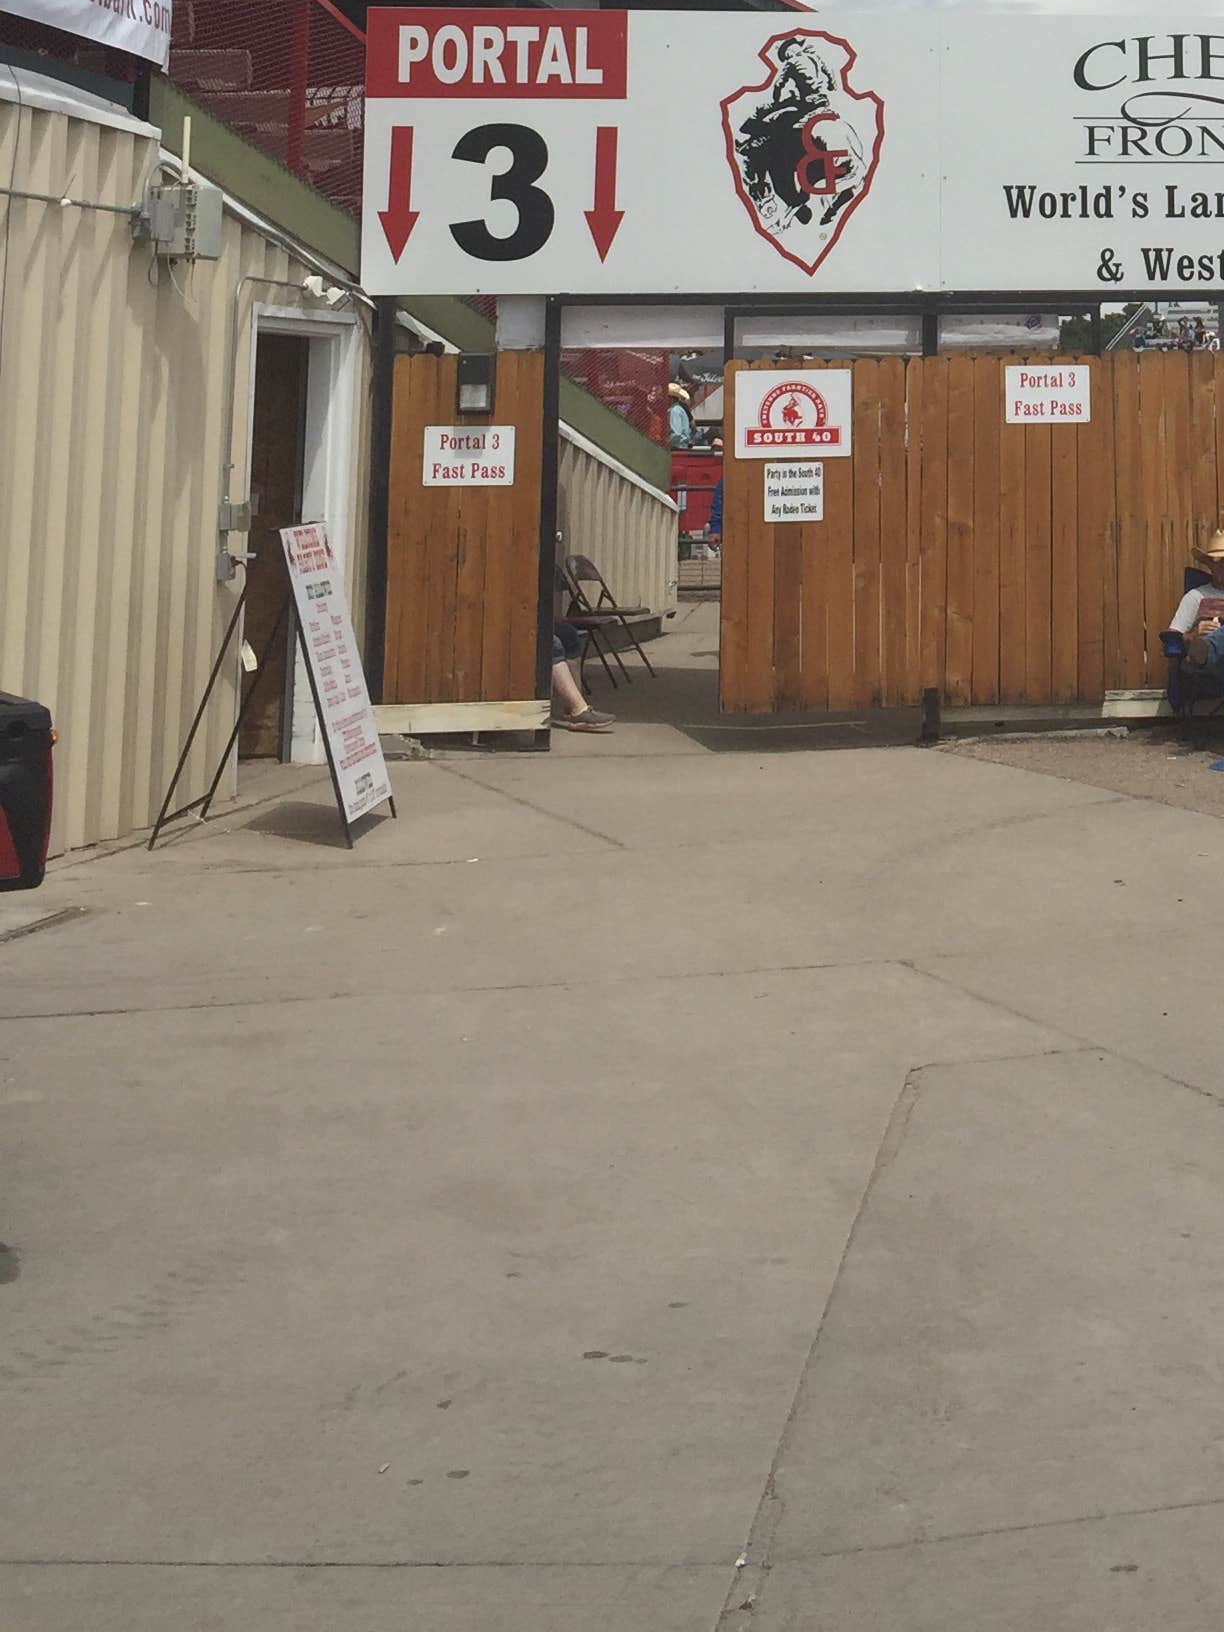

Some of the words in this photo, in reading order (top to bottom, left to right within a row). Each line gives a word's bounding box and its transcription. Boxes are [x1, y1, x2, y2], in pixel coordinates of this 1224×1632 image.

[398, 24, 604, 85] PORTAL
[448, 122, 555, 262] 3
[1003, 184, 1150, 219] World's
[1096, 247, 1125, 282] &
[1020, 371, 1063, 388] Portal
[1068, 371, 1076, 388] 3
[1014, 400, 1045, 417] Fast
[1050, 400, 1083, 416] Pass
[440, 433, 486, 450] Portal
[492, 433, 500, 450] 3
[753, 431, 806, 444] SOUTH
[812, 431, 832, 443] 40
[432, 462, 466, 479] Fast
[470, 462, 506, 479] Pass
